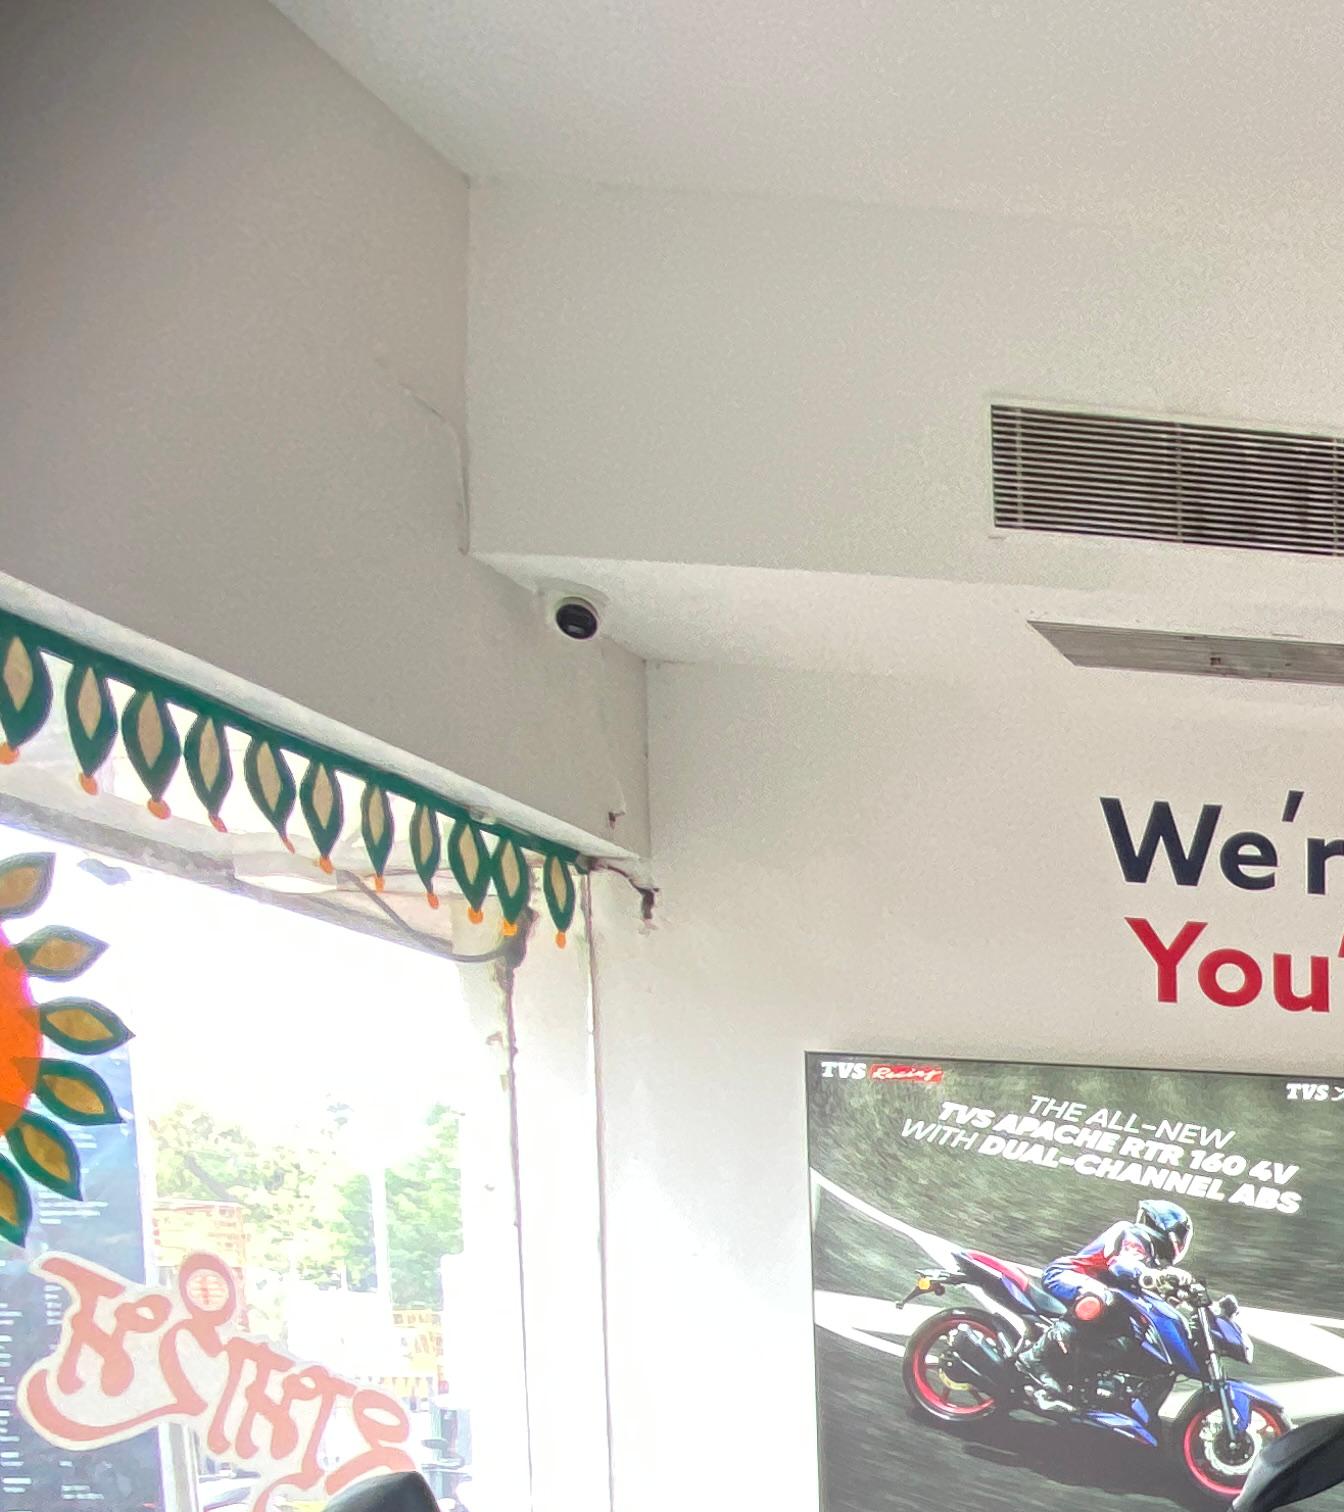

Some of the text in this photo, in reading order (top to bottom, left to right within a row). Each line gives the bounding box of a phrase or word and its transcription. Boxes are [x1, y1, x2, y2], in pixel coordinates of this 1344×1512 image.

[821, 1062, 867, 1080] TVS
[1286, 1083, 1330, 1101] TVS
[938, 1101, 1300, 1186] TVS APACHE RTR 160 4V
[1029, 1094, 1236, 1150] THE ALL-NEW
[901, 1118, 1303, 1216] WITH DUAL-CHANNEL ABS
